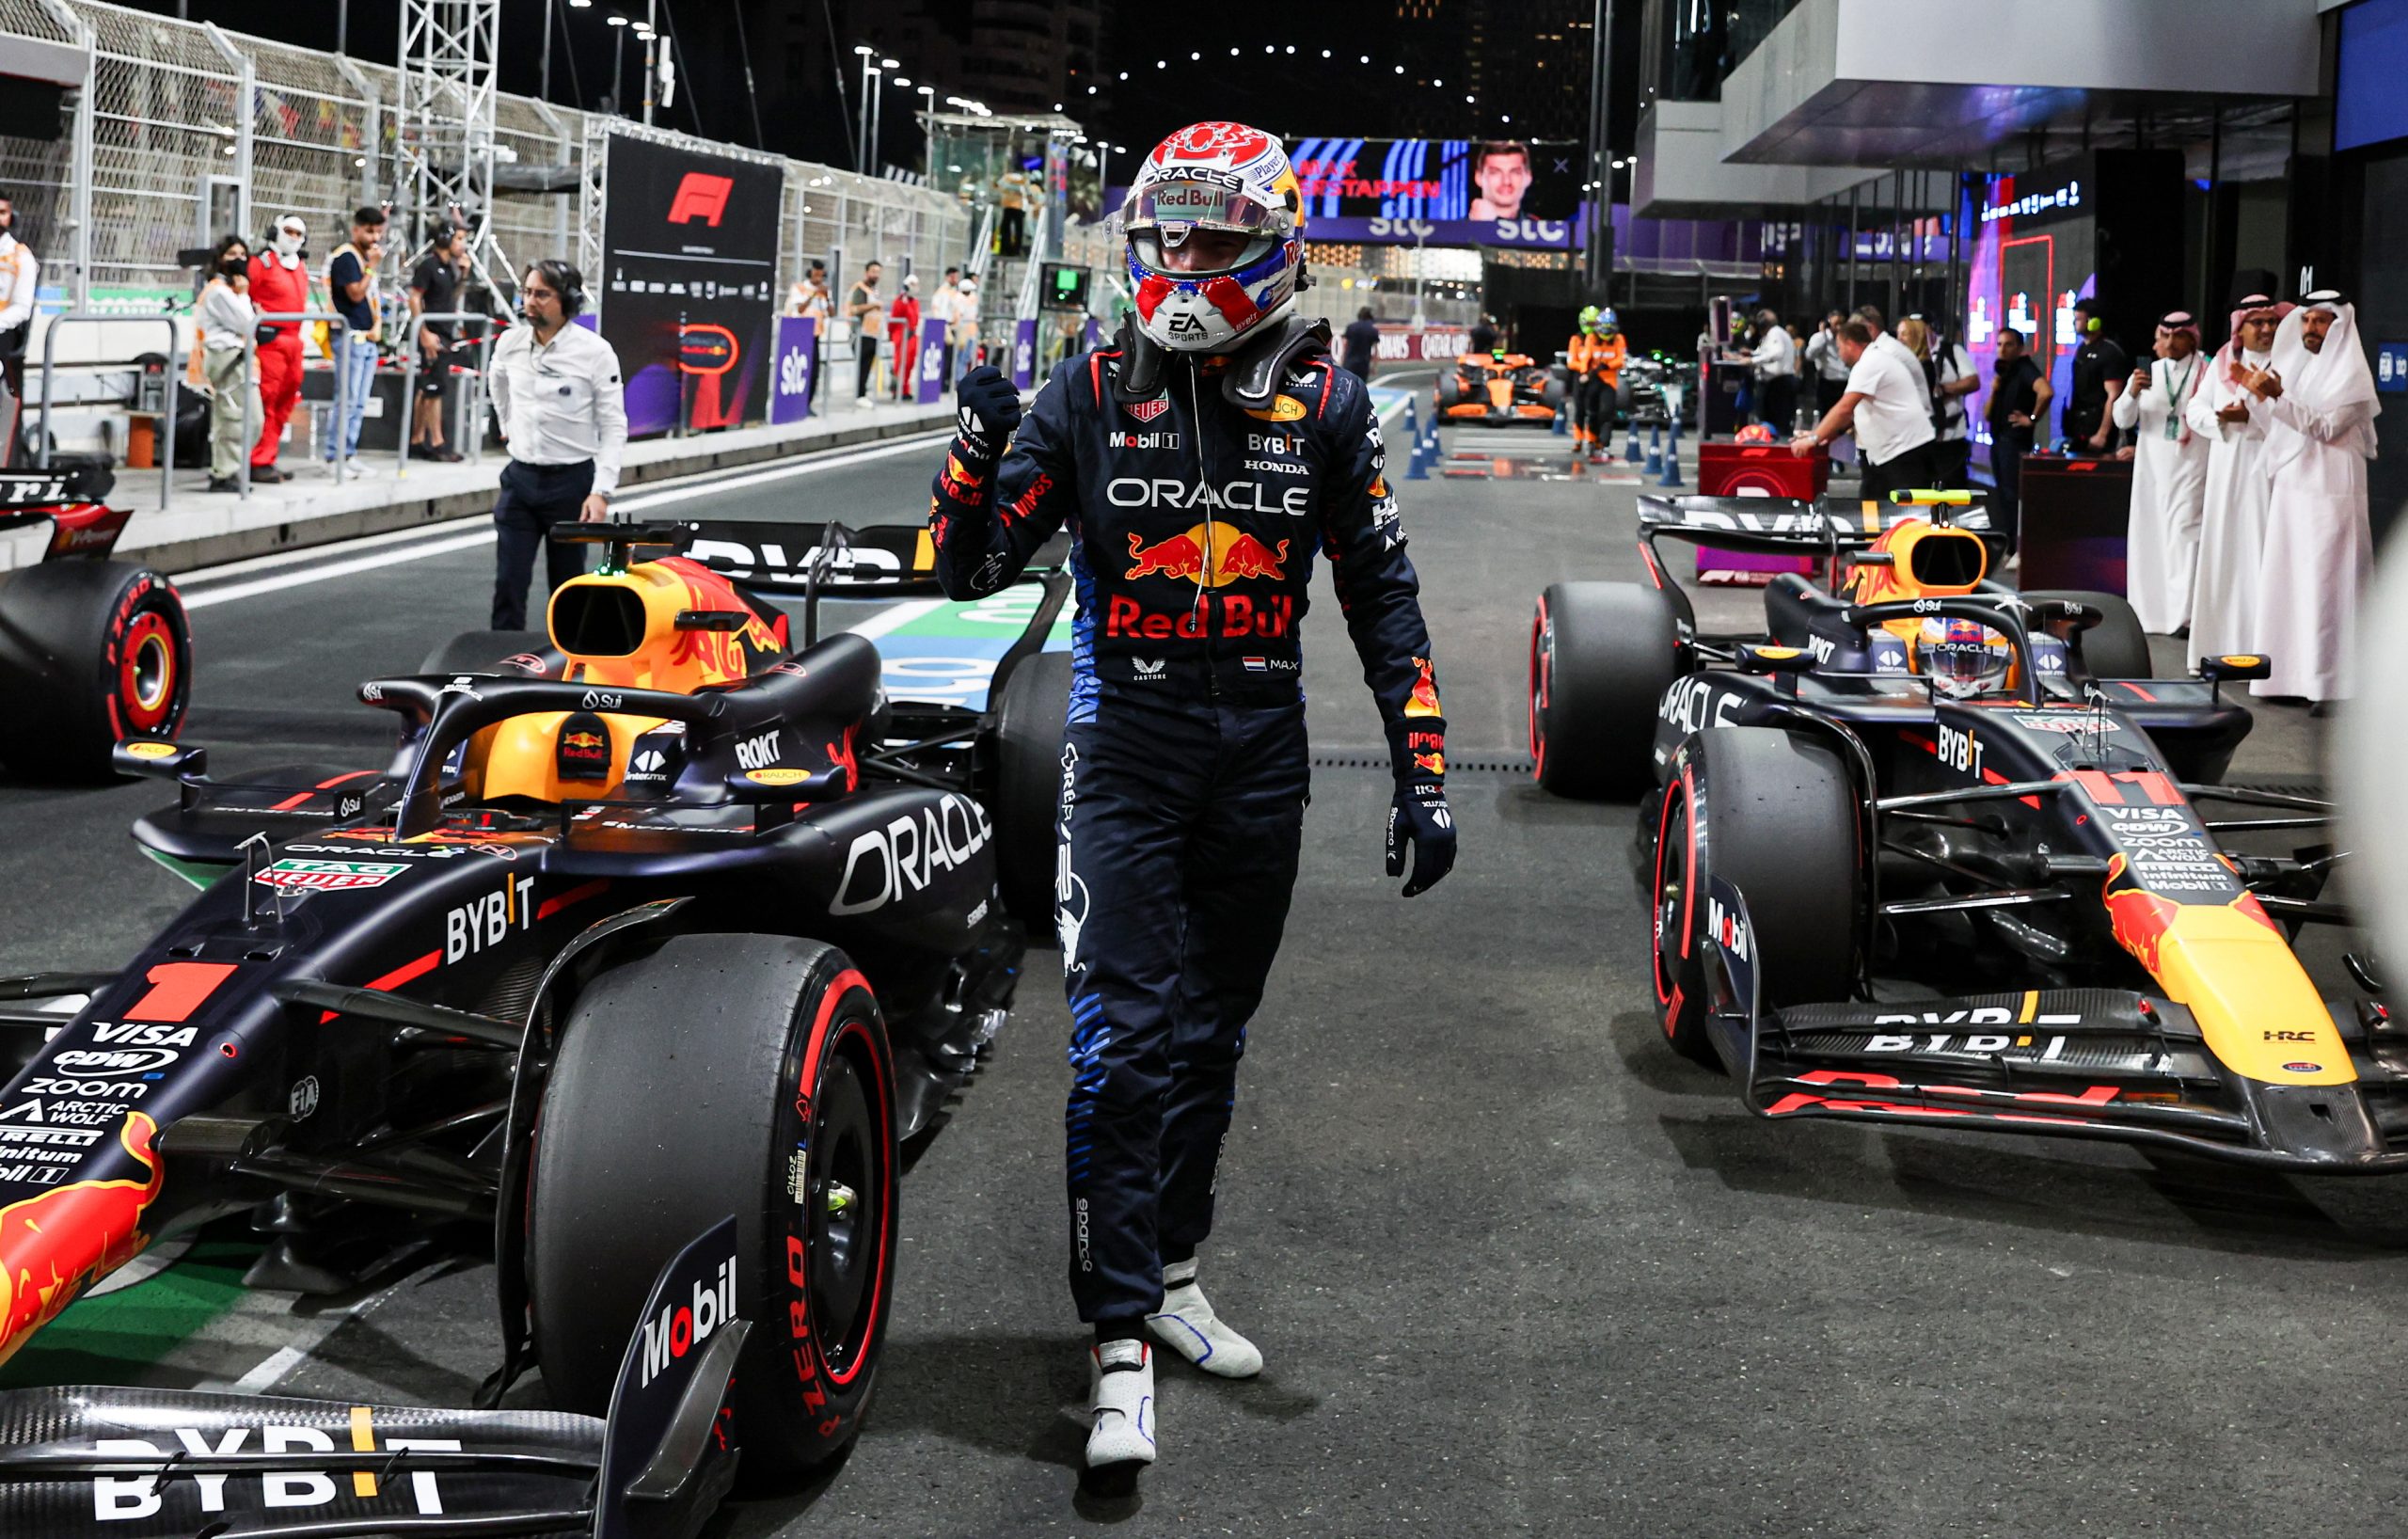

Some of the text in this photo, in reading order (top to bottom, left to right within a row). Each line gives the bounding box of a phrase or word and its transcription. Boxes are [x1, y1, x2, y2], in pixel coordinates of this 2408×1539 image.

[1145, 167, 1240, 190] ORACLE
[1298, 159, 1357, 178] MAX
[1157, 189, 1224, 207] Red Bull
[1298, 179, 1440, 198] ERSTAPPEN
[1284, 240, 1302, 269] Re
[1169, 312, 1207, 332] EA
[781, 345, 807, 396] stc
[923, 341, 942, 381] stc
[1109, 432, 1160, 449] Mobil
[1248, 434, 1305, 456] BYBIT
[1244, 460, 1309, 475] HONDA
[1106, 477, 1310, 516] ORACLE
[1106, 593, 1293, 639] Red Bull
[1936, 643, 1991, 655] ORACLE
[1270, 659, 1299, 671] MAX
[600, 694, 622, 708] Sui
[735, 730, 781, 770] ROKT
[1939, 723, 1984, 779] BYBIT
[625, 771, 667, 782] inter.mx
[763, 771, 802, 780] RAUCH
[349, 797, 361, 813] Sui
[2100, 807, 2183, 820] VISA
[1387, 806, 1399, 846] sparco
[2112, 822, 2177, 833] CDW
[2120, 837, 2204, 848] zoom
[829, 793, 992, 916] ORACLE
[287, 861, 395, 874] TAG
[2142, 871, 2227, 881] infinitum
[262, 871, 386, 887] HEUER
[2147, 881, 2210, 891] Mobil
[447, 872, 534, 965] BYBIT
[1708, 896, 1748, 962] Mobil
[122, 962, 239, 1023] 1
[91, 1022, 198, 1047] VISA
[1863, 990, 2082, 1059] BYBIT
[2263, 1031, 2315, 1040] HRC
[54, 1049, 164, 1071] CDW
[21, 1077, 149, 1099] zoom
[46, 1100, 130, 1115] ARCTIC
[49, 1112, 113, 1125] WOLF
[1076, 1197, 1093, 1273] sparco
[642, 1254, 737, 1389] Mobil
[787, 1234, 841, 1439] P ZERO
[94, 1406, 463, 1521] BYBIT
